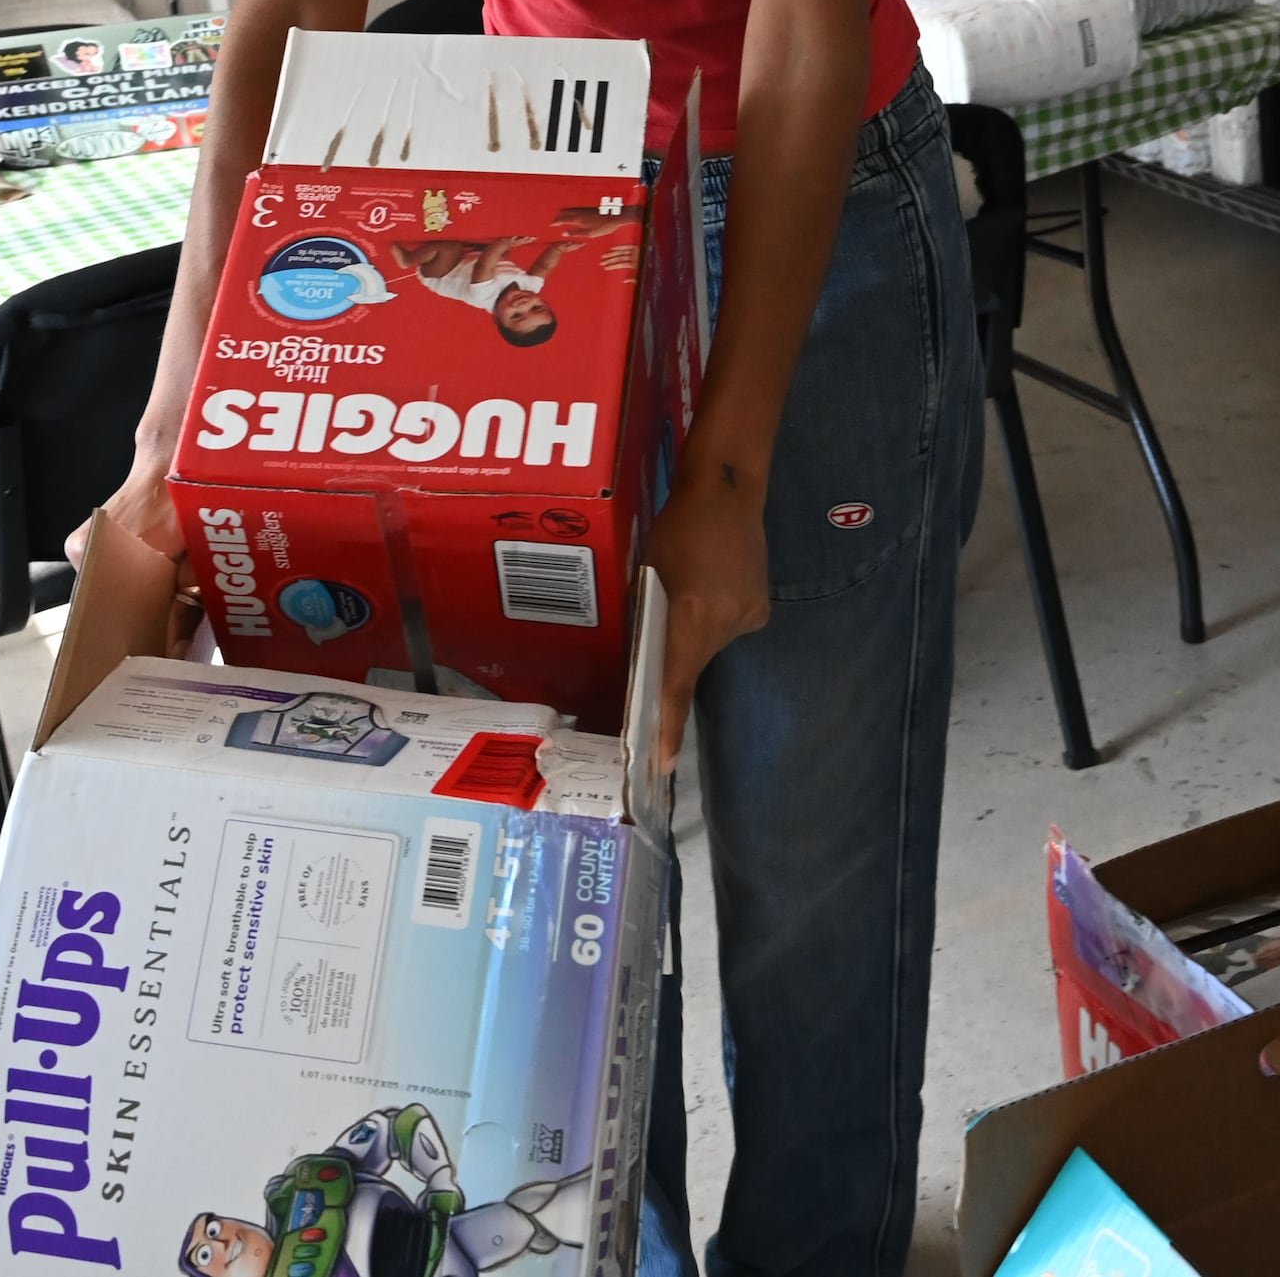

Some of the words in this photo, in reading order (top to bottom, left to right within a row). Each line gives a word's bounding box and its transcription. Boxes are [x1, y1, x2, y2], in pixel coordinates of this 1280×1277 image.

[61, 77, 170, 99] CALL
[86, 71, 135, 85] OUT
[142, 63, 214, 80] MURA
[146, 83, 213, 103] LAMA
[252, 194, 281, 229] 3
[298, 202, 328, 219] 76
[216, 333, 386, 367] snugglers
[274, 362, 329, 384] little
[196, 388, 599, 468] HUGGIES
[260, 510, 292, 570] snugglers
[198, 507, 273, 637] HUGGIES
[241, 832, 257, 861] help
[240, 865, 251, 879] to
[302, 863, 314, 880] OF
[575, 836, 598, 902] COUNT
[298, 880, 310, 909] FREE
[358, 879, 370, 909] SANS
[9, 889, 29, 954] Dermatologues
[225, 882, 249, 953] breathable
[228, 965, 252, 1035] protect
[242, 879, 267, 961] sensitive
[256, 837, 275, 875] skin
[570, 914, 605, 966] 60
[5, 969, 14, 985] par
[6, 955, 17, 969] les
[223, 956, 234, 967] &
[218, 970, 233, 997] soft
[289, 975, 306, 1013] 100%
[300, 972, 314, 1018] Leakproof
[323, 968, 336, 1016] protection
[100, 1097, 142, 1205] SKIN
[122, 824, 193, 1086] ESSENTIALS
[211, 1000, 227, 1035] Ultra
